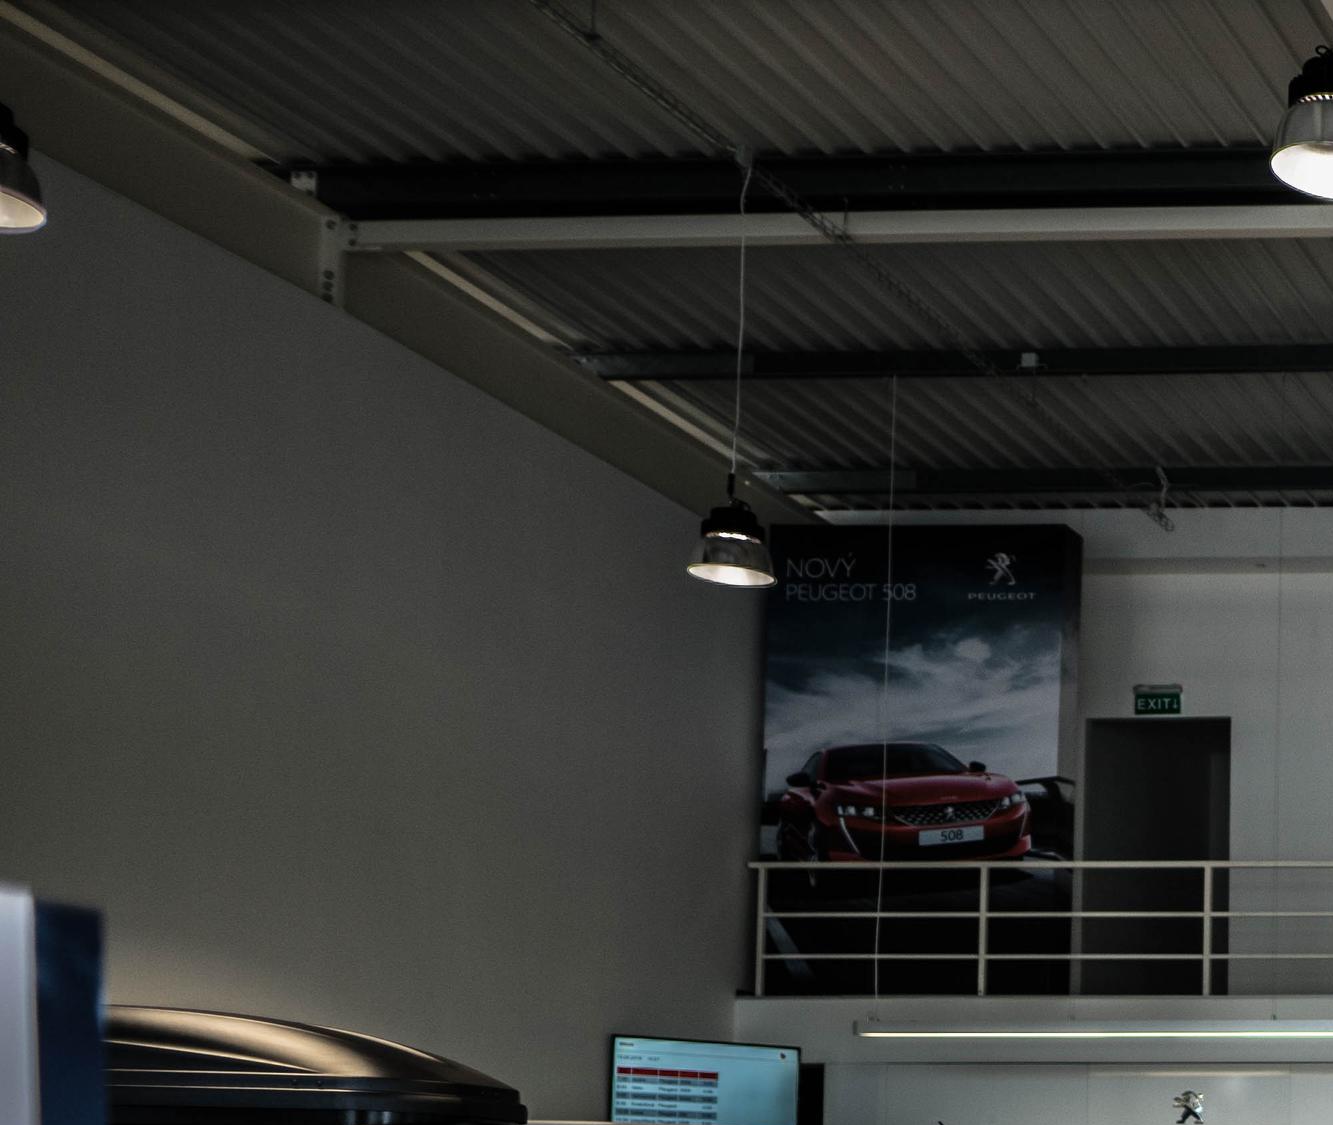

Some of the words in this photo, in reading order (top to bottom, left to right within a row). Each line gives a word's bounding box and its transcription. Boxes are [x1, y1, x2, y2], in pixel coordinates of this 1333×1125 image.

[786, 552, 856, 578] NOVÝ
[785, 583, 876, 601] PEUGEOT
[881, 583, 917, 601] 508
[967, 592, 1037, 600] PEUGEOT
[1137, 698, 1171, 710] EXIT
[940, 829, 964, 842] 508
